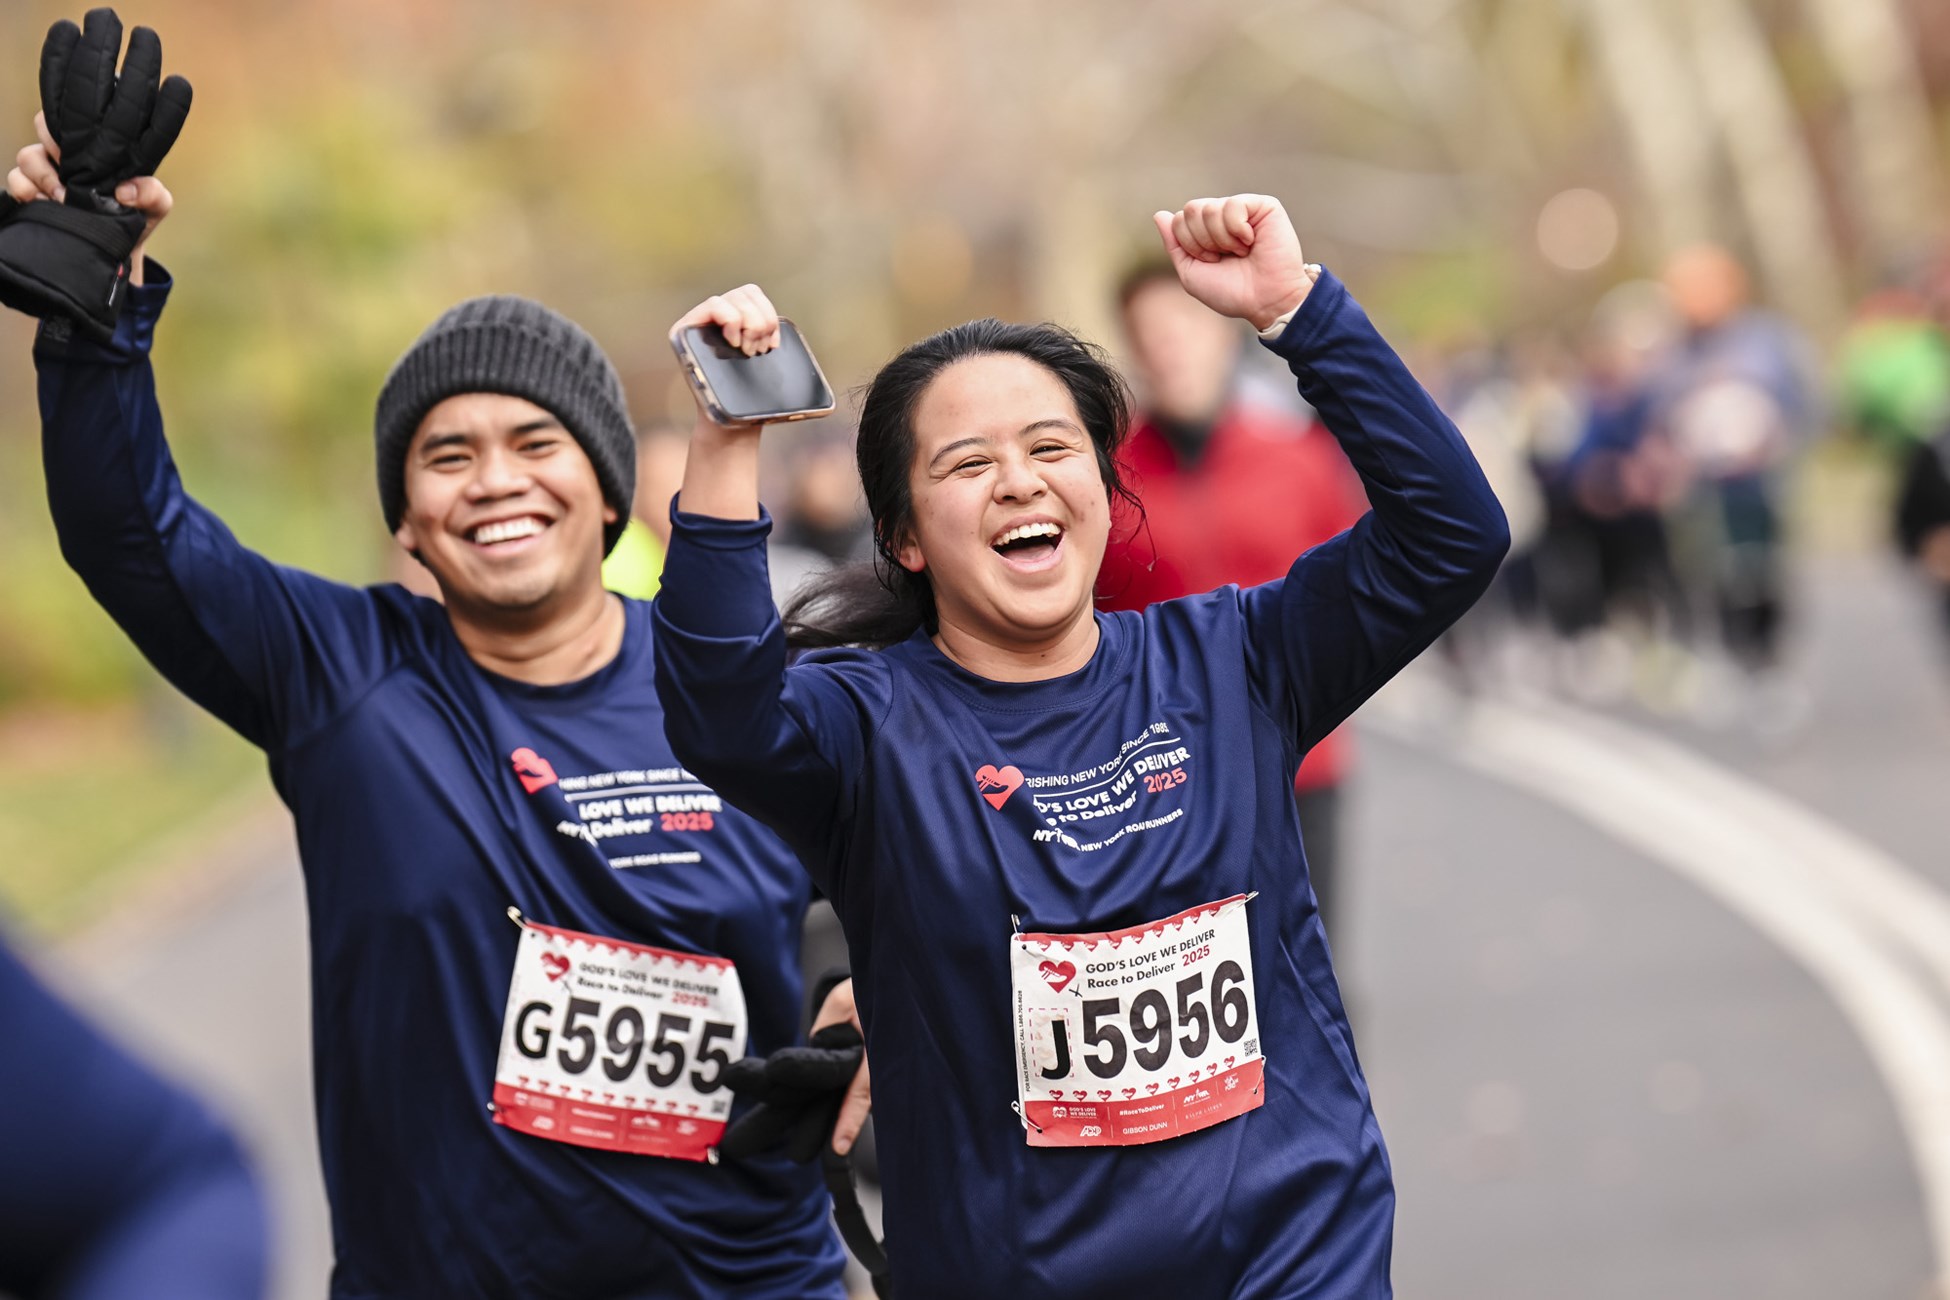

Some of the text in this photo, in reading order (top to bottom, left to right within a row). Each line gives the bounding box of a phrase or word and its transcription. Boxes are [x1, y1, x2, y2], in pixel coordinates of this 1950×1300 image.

[1065, 791, 1111, 811] LOVE
[1111, 769, 1135, 796] WE
[1133, 747, 1191, 776] DELIVER
[1071, 767, 1097, 784] NEW
[1099, 751, 1123, 774] YORK
[1121, 729, 1150, 754] SINCE
[579, 799, 624, 820] LOVE
[624, 796, 655, 815] WE
[1080, 790, 1137, 820] Deliver
[1143, 767, 1188, 794] 2025
[660, 812, 715, 832] 2025
[1081, 842, 1103, 852] NEW
[1104, 828, 1125, 847] YORK
[1145, 808, 1184, 830] RUNNERS
[1086, 929, 1215, 974] GOD'S LOVE WE DELIVER
[1087, 944, 1210, 989] Race to Deliver 2025
[1122, 1121, 1168, 1135] GIBSON DUNN
